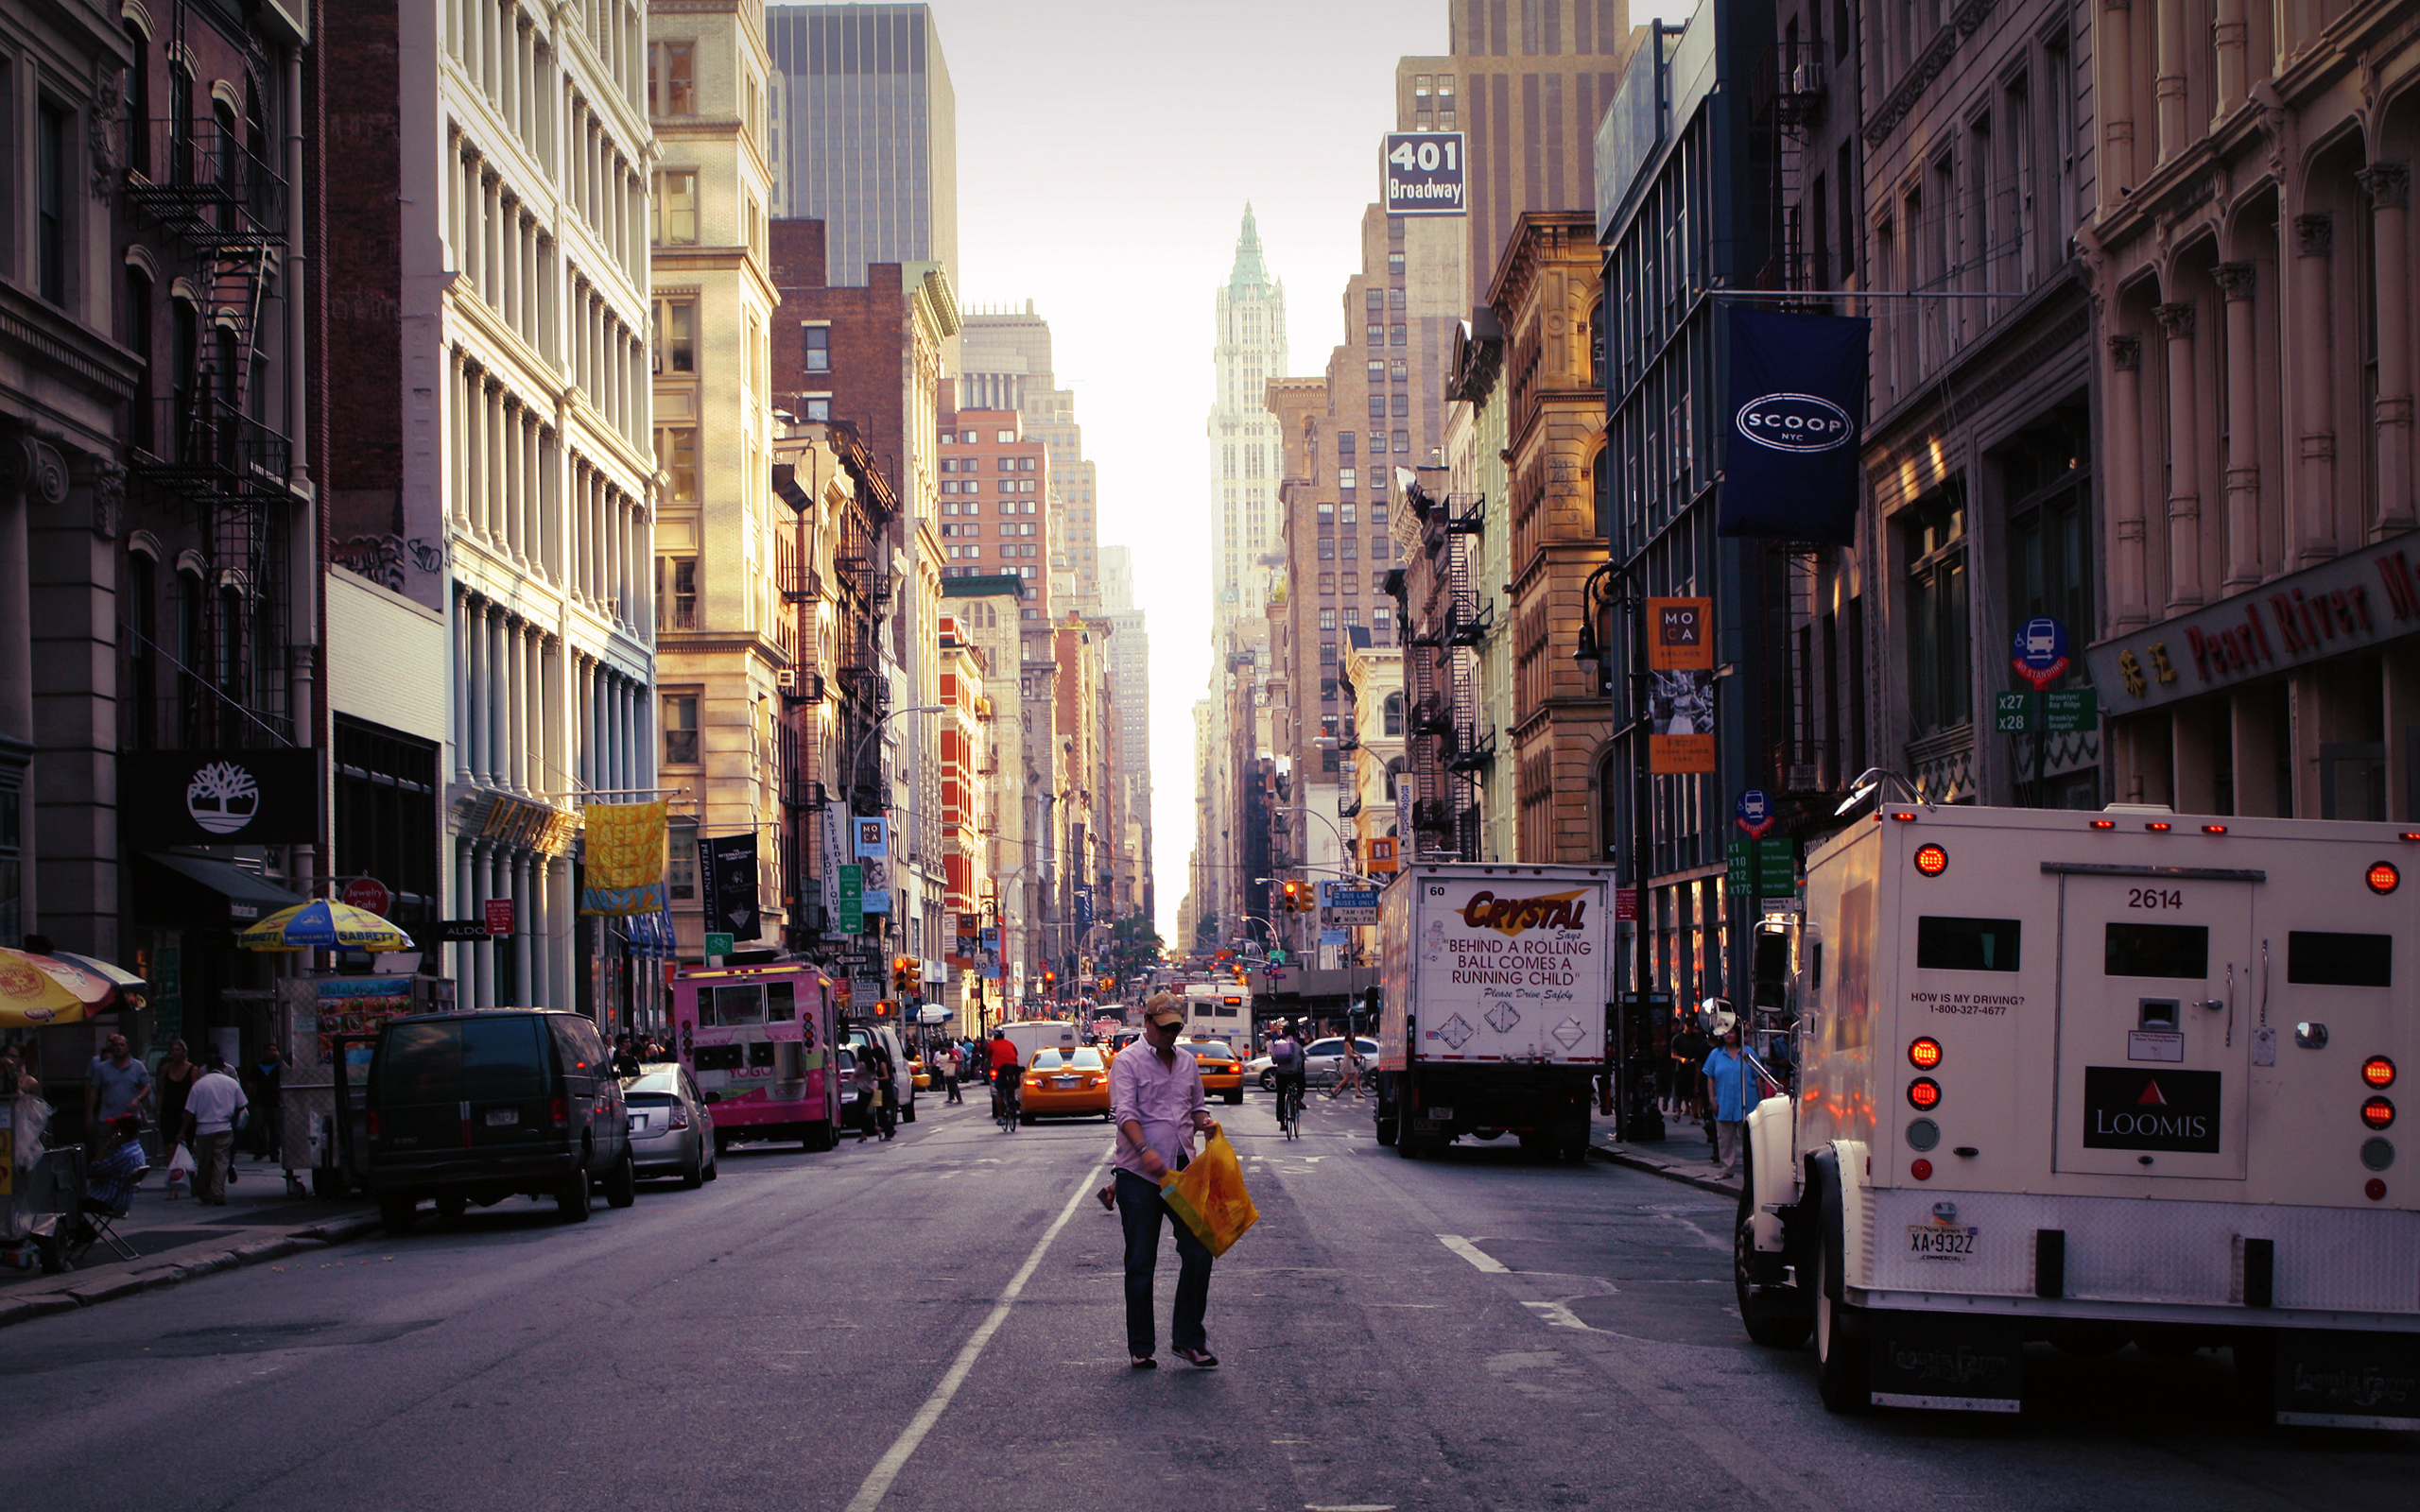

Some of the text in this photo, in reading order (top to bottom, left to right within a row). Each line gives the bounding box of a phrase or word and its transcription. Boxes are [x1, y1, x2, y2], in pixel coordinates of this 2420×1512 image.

[1390, 142, 1456, 171] 401
[1391, 178, 1461, 204] Broadway
[1749, 413, 1841, 433] SCOOP
[1781, 433, 1803, 441] NYC
[2184, 602, 2273, 681] Pearl
[2270, 585, 2373, 654] River
[2016, 660, 2065, 679] NO STANDING
[1728, 857, 1746, 868] x10
[1729, 871, 1747, 881] x12
[348, 887, 383, 898] Jewelry
[1430, 886, 1445, 896] 60
[1729, 885, 1753, 895] x17C
[580, 883, 662, 910] DAFFY'S
[2128, 888, 2183, 910] 2614
[1463, 891, 1586, 930] CRYSTAL
[338, 931, 395, 941] SABRETT
[447, 926, 485, 935] ALDO
[1555, 930, 1582, 941] Says
[1508, 940, 1519, 954] A
[1524, 941, 1592, 954] ROLLING
[1458, 955, 1572, 971] BALL COMES A
[1452, 971, 1523, 985] RUNNING
[1483, 988, 1573, 1001] Please Drive Safely
[1910, 993, 2025, 1005] HOW IS MY DRIVING?
[1929, 1005, 2006, 1016] 1-800-327-4677
[729, 1066, 773, 1078] YOGO
